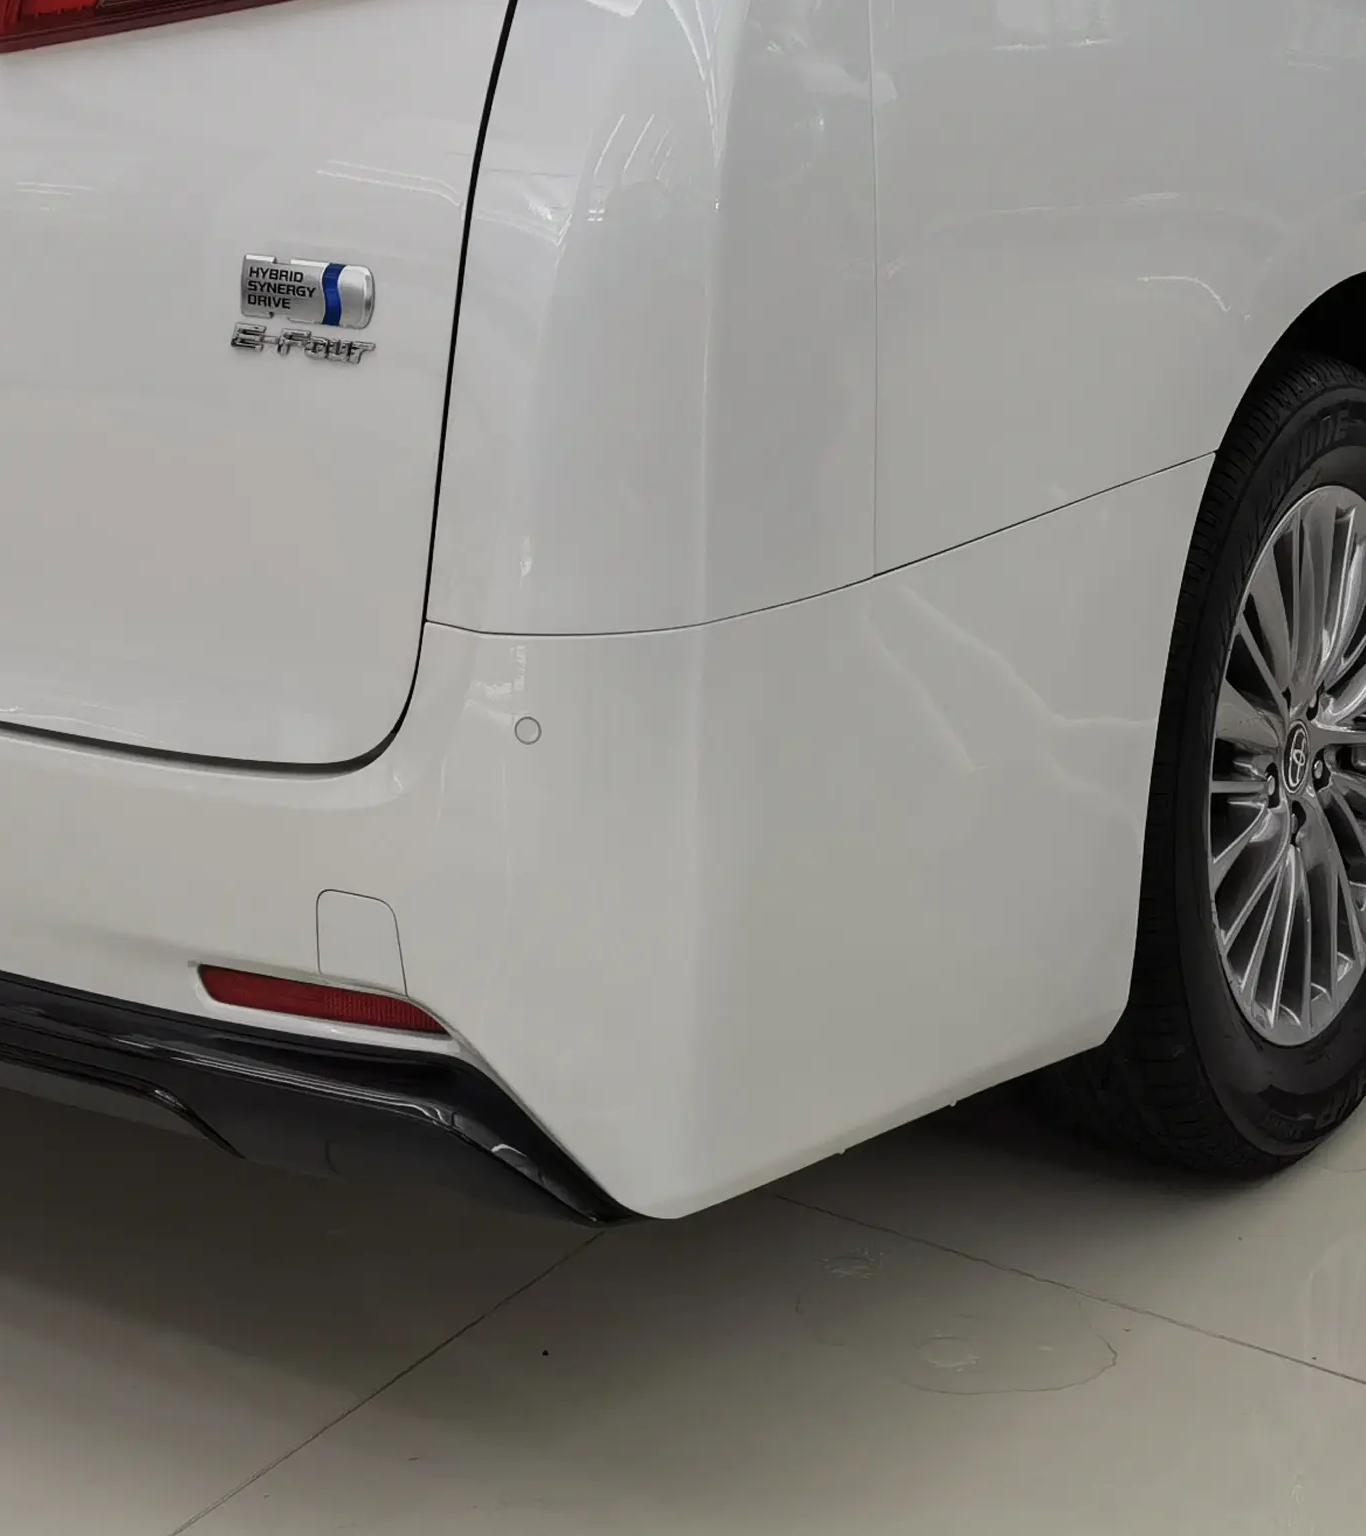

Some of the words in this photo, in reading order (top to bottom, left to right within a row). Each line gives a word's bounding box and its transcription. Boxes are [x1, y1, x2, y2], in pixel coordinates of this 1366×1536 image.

[248, 266, 303, 282] HYBRID
[247, 280, 316, 299] SYNERGY
[247, 294, 291, 310] DRIVE
